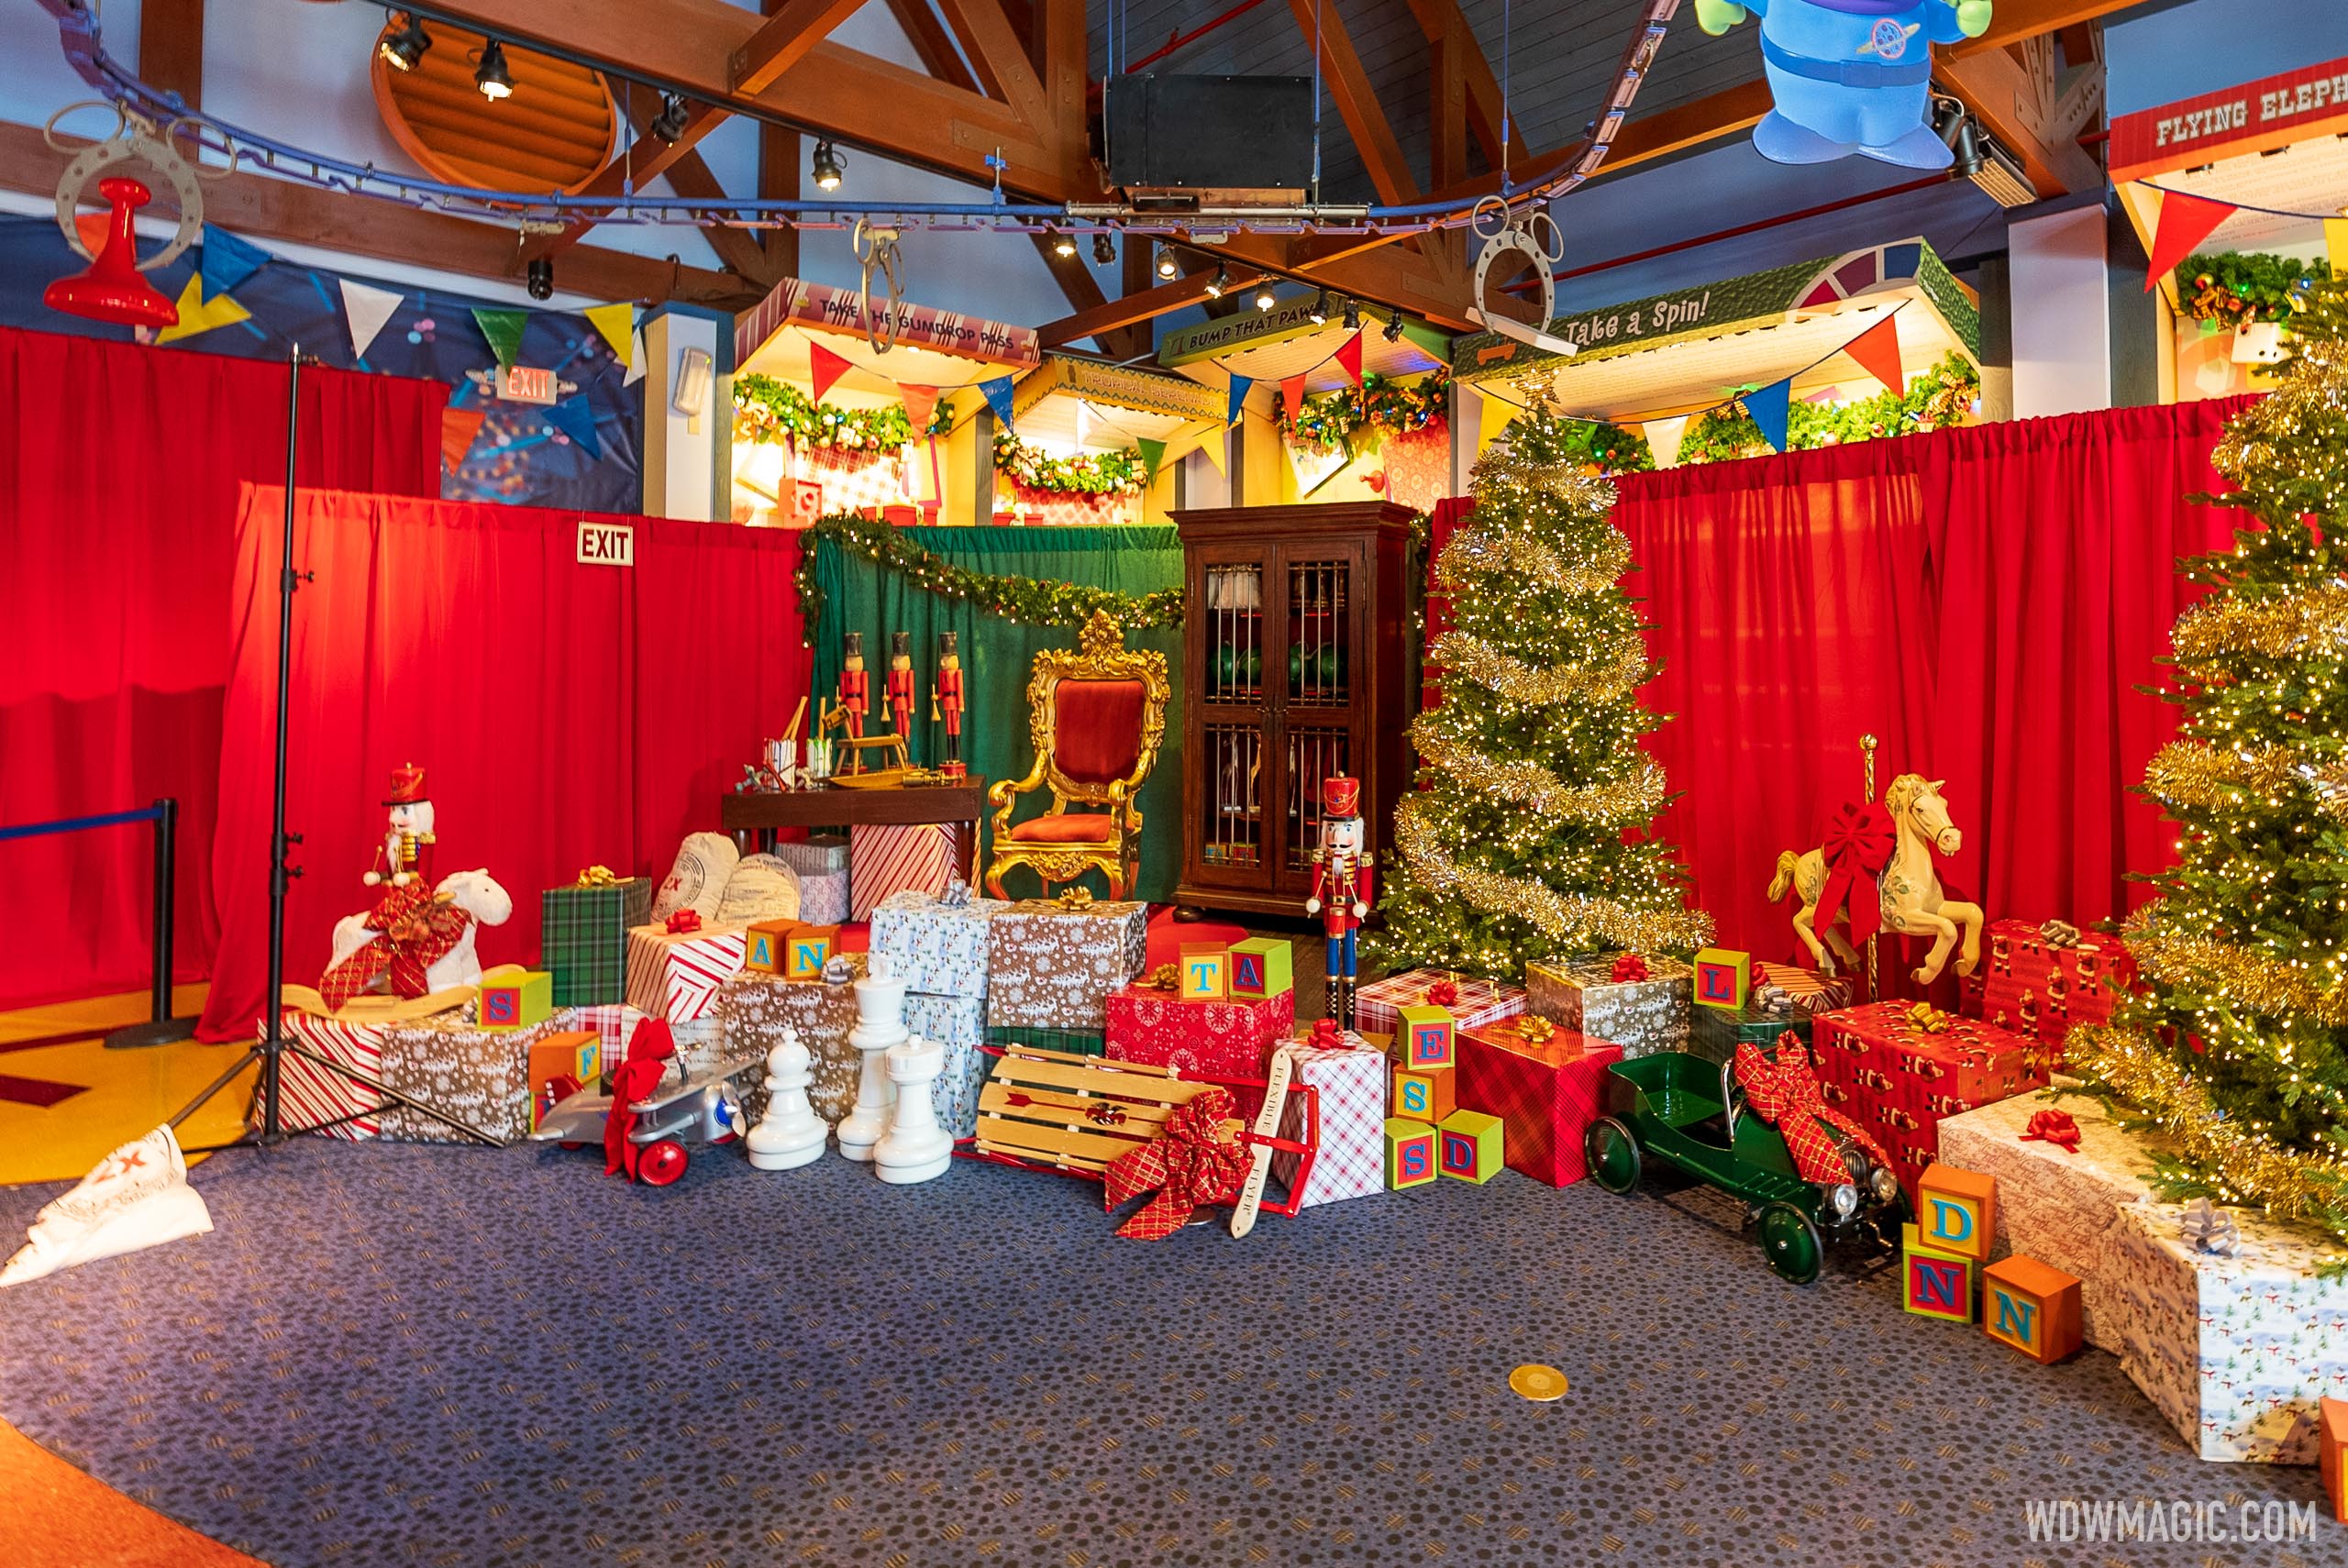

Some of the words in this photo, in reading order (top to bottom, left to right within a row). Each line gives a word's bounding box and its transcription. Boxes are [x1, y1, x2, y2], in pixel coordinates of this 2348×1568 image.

[2156, 99, 2247, 147] FLYING
[820, 299, 858, 319] TAKE
[900, 315, 975, 341] GUMDROP
[980, 332, 1013, 349] PASS
[1189, 327, 1230, 349] BUMP
[1235, 313, 1277, 337] THAT
[1567, 315, 1619, 346] Take
[1626, 312, 1643, 336] a
[1652, 291, 1711, 332] Spin!
[507, 367, 550, 399] EXIT
[1081, 370, 1146, 395] TROPICAL
[1150, 384, 1219, 408] SERENADE
[581, 528, 628, 560] EXIT
[751, 938, 772, 965] A
[795, 943, 827, 971] N
[1191, 963, 1217, 992] T
[1235, 957, 1262, 987] A
[1704, 968, 1730, 999] L
[489, 992, 513, 1021] S
[581, 1044, 597, 1077] F
[1417, 1029, 1445, 1060] E
[1261, 1066, 1284, 1129] FLEXIBLE
[1403, 1081, 1427, 1112] S
[1404, 1143, 1426, 1176] S
[1445, 1136, 1473, 1170] D
[1931, 1198, 1974, 1242] D
[1916, 1263, 1960, 1307] N
[1995, 1290, 2036, 1342] N
